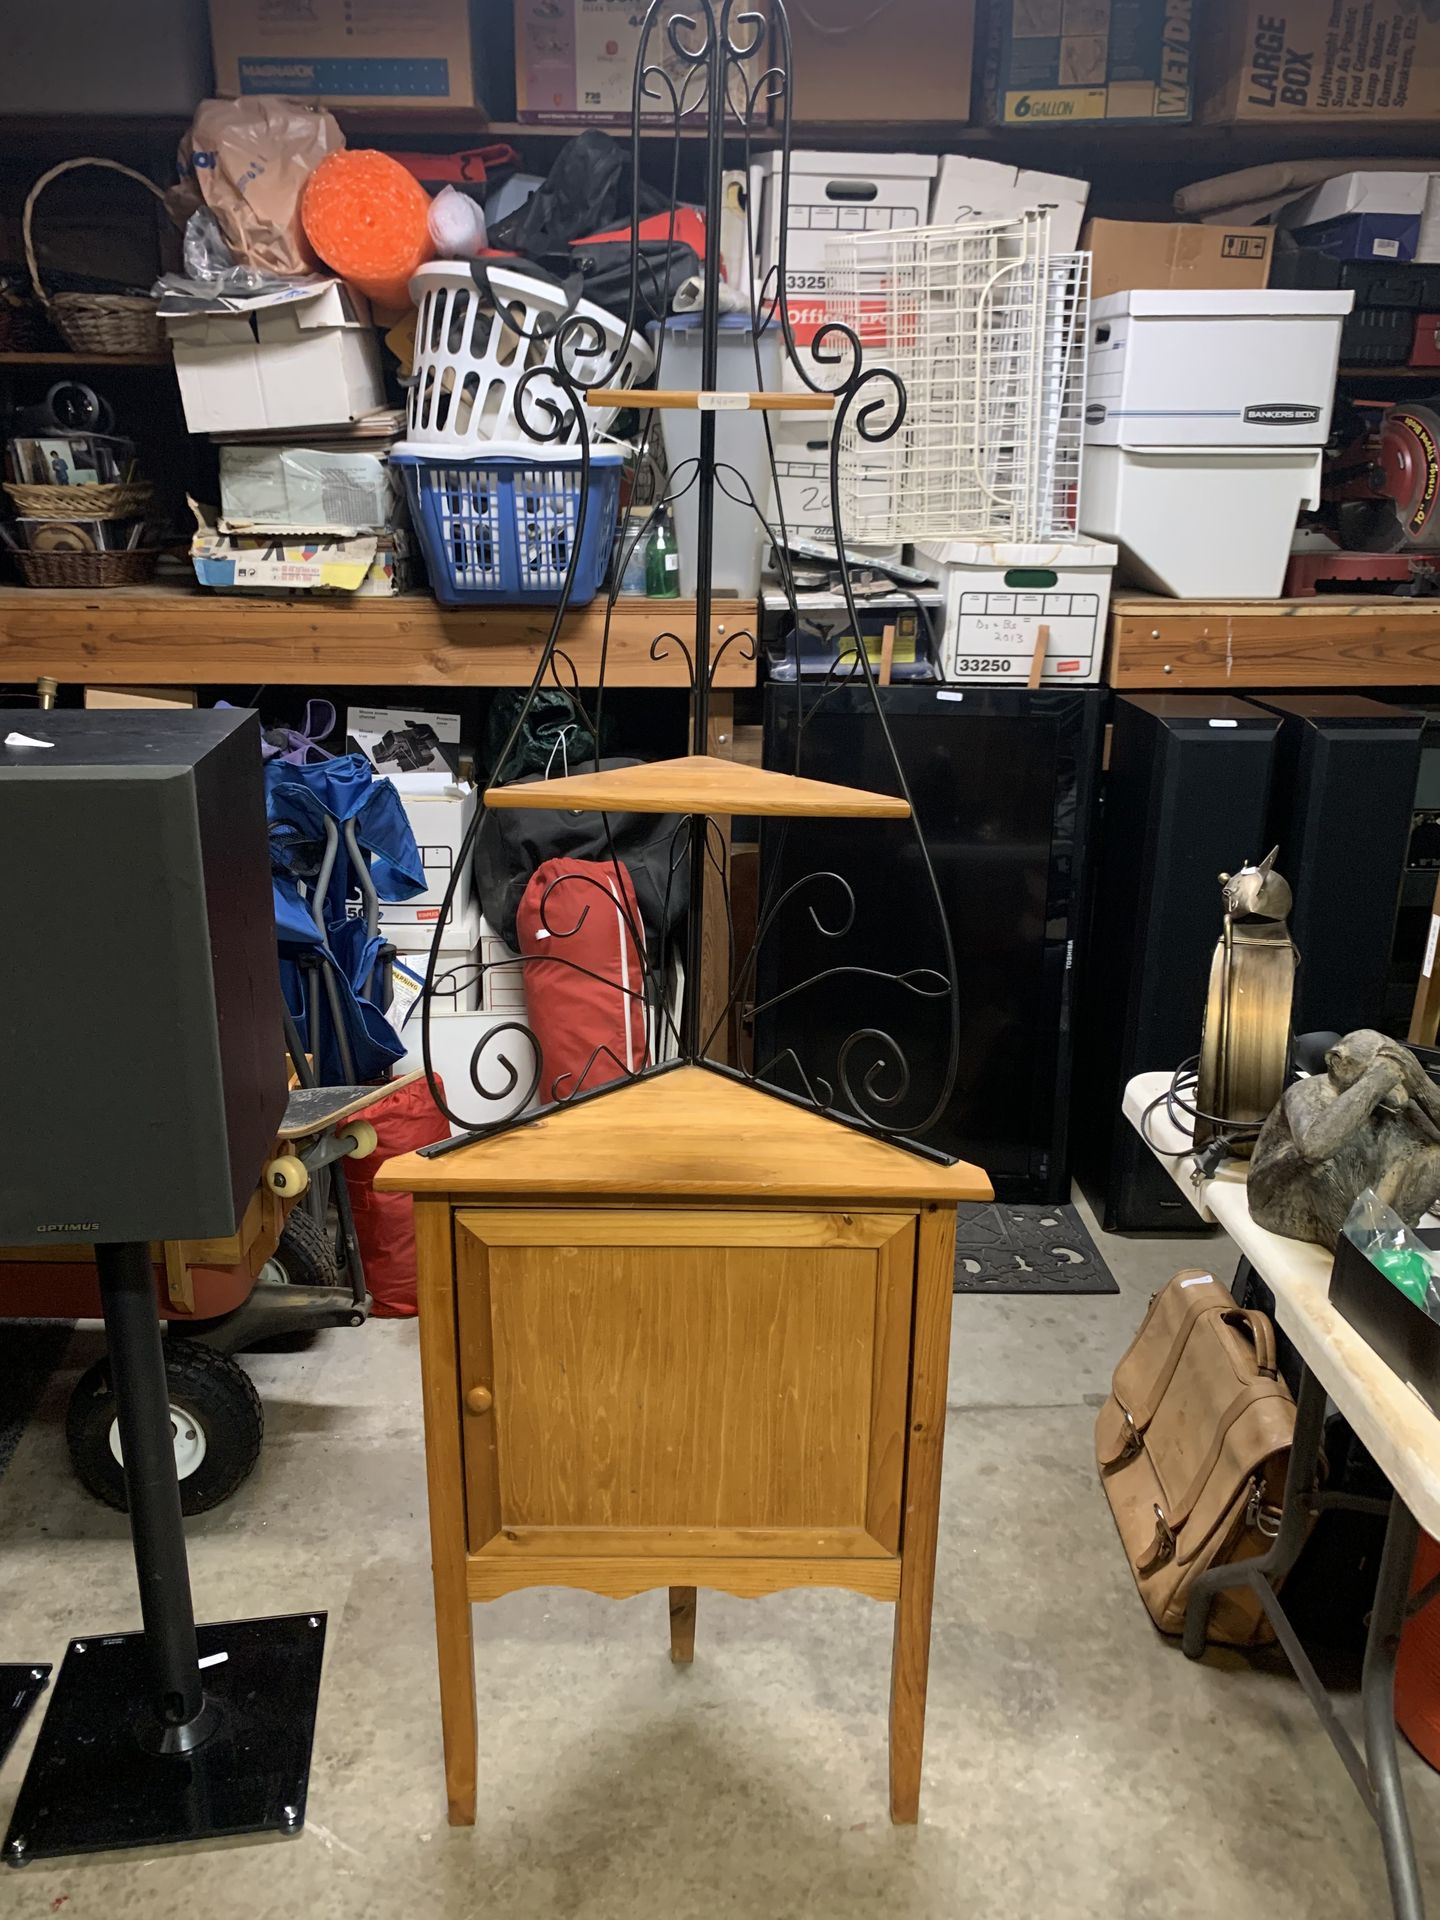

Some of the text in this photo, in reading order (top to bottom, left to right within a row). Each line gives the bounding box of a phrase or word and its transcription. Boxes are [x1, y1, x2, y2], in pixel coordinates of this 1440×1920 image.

[1248, 14, 1286, 108] LARGE
[1280, 47, 1315, 107] BOX
[1316, 32, 1339, 108] Lightweight
[1337, 55, 1350, 73] As
[1393, 45, 1416, 108] Speakers,
[1014, 96, 1075, 117] 6 GALLON
[1332, 75, 1348, 108] Such
[1347, 75, 1363, 108] Food
[1362, 73, 1381, 108] Lamp
[1248, 409, 1316, 419] BANKERS BOX
[959, 659, 1011, 672] 33250
[1065, 939, 1073, 970] TOSHIBA
[36, 1223, 100, 1232] OPTIMUS
